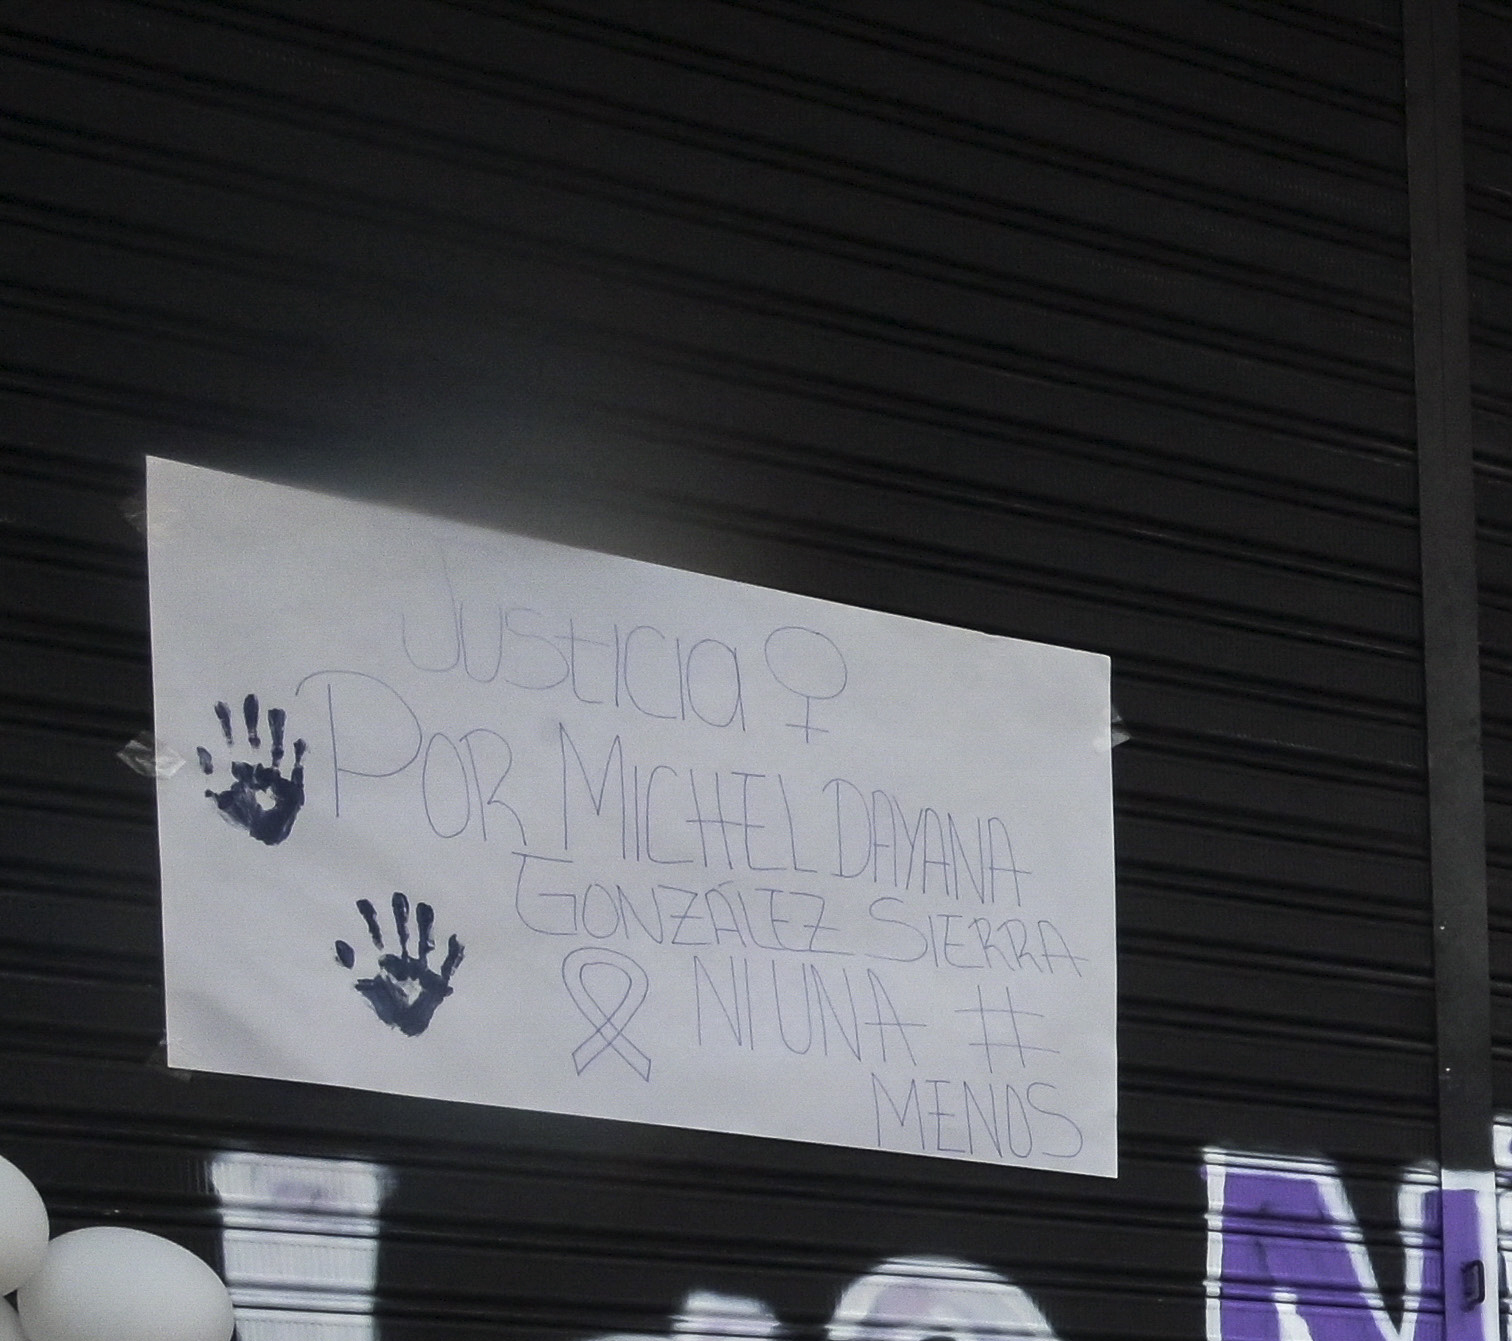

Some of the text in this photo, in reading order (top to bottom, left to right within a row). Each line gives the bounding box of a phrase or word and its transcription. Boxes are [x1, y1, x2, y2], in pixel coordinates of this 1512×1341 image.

[296, 669, 1032, 907] POR MICHEL DAYANA
[864, 896, 1089, 977] SIERRA
[693, 955, 754, 1051] NI
[771, 959, 927, 1066] UNA
[870, 1073, 1083, 1159] MENOS
